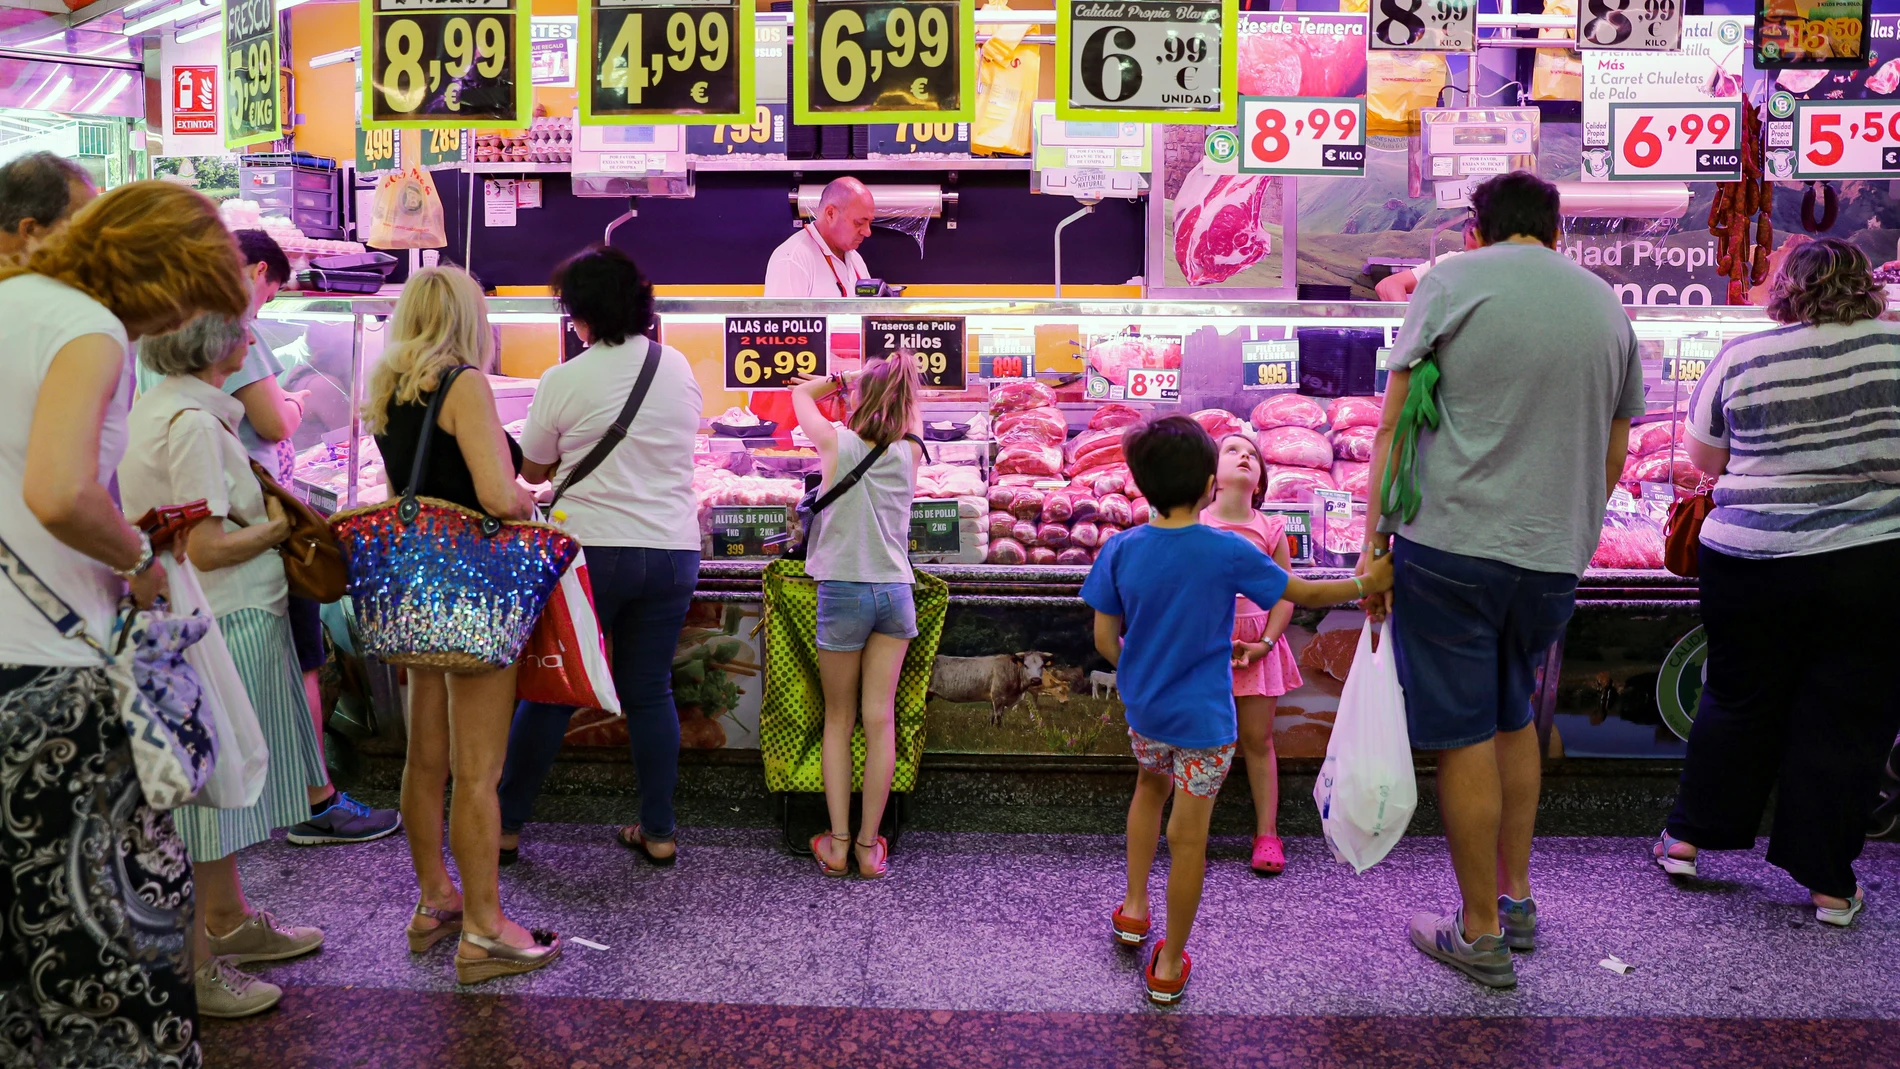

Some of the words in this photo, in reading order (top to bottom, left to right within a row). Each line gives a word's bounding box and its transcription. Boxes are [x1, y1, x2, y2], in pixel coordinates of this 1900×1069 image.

[1075, 4, 1124, 17] Calidad
[1127, 5, 1171, 21] Propia
[229, 0, 271, 39] FRESCO
[1272, 16, 1293, 34] de
[1298, 17, 1363, 36] Ternera
[1871, 20, 1894, 38] llas
[1645, 39, 1667, 47] KILO
[601, 12, 729, 104] 4,99
[820, 7, 948, 102] 6,99
[384, 17, 505, 112] 8,99
[1598, 60, 1625, 70] Más
[1174, 66, 1199, 91] €
[1590, 75, 1596, 84] 1
[1601, 73, 1643, 84] Carret
[1647, 72, 1703, 84] Chuletas
[230, 40, 272, 130] 5,99
[910, 77, 929, 99] €
[690, 82, 709, 103] €
[1162, 94, 1211, 104] UNIDAD
[1590, 87, 1605, 99] de
[1609, 88, 1637, 99] Palo
[248, 99, 273, 126] €/KG
[177, 120, 214, 128] EXTINTOR
[774, 115, 784, 142] EUROS
[1585, 121, 1607, 130] Calidad
[1251, 109, 1357, 163] 8,99
[1586, 130, 1605, 138] Propia
[1771, 131, 1789, 140] Propia
[1623, 114, 1730, 168] 6,99
[1325, 149, 1336, 161] €
[1339, 151, 1363, 161] KILO
[1699, 154, 1710, 166] €
[1713, 156, 1738, 165] KILO
[1885, 152, 1897, 164] €
[1634, 240, 1720, 273] Propi
[728, 320, 761, 333] ALAS
[764, 320, 779, 333] de
[782, 320, 823, 333] POLLO
[871, 322, 914, 331] Traseros
[916, 322, 929, 331] de
[931, 322, 956, 331] Pollo
[740, 336, 750, 344] 2
[755, 336, 808, 344] KILOS
[884, 333, 895, 348] 2
[900, 333, 942, 348] kilos
[1256, 344, 1286, 352] FILETES
[1260, 351, 1296, 360] TERNERA
[735, 349, 817, 384] 6,99
[934, 376, 941, 384] €
[1131, 373, 1176, 396] 8,99
[715, 514, 744, 524] ALITAS
[746, 514, 756, 523] DE
[758, 513, 784, 523] POLLO
[925, 509, 934, 518] DE
[935, 508, 956, 518] POLLO
